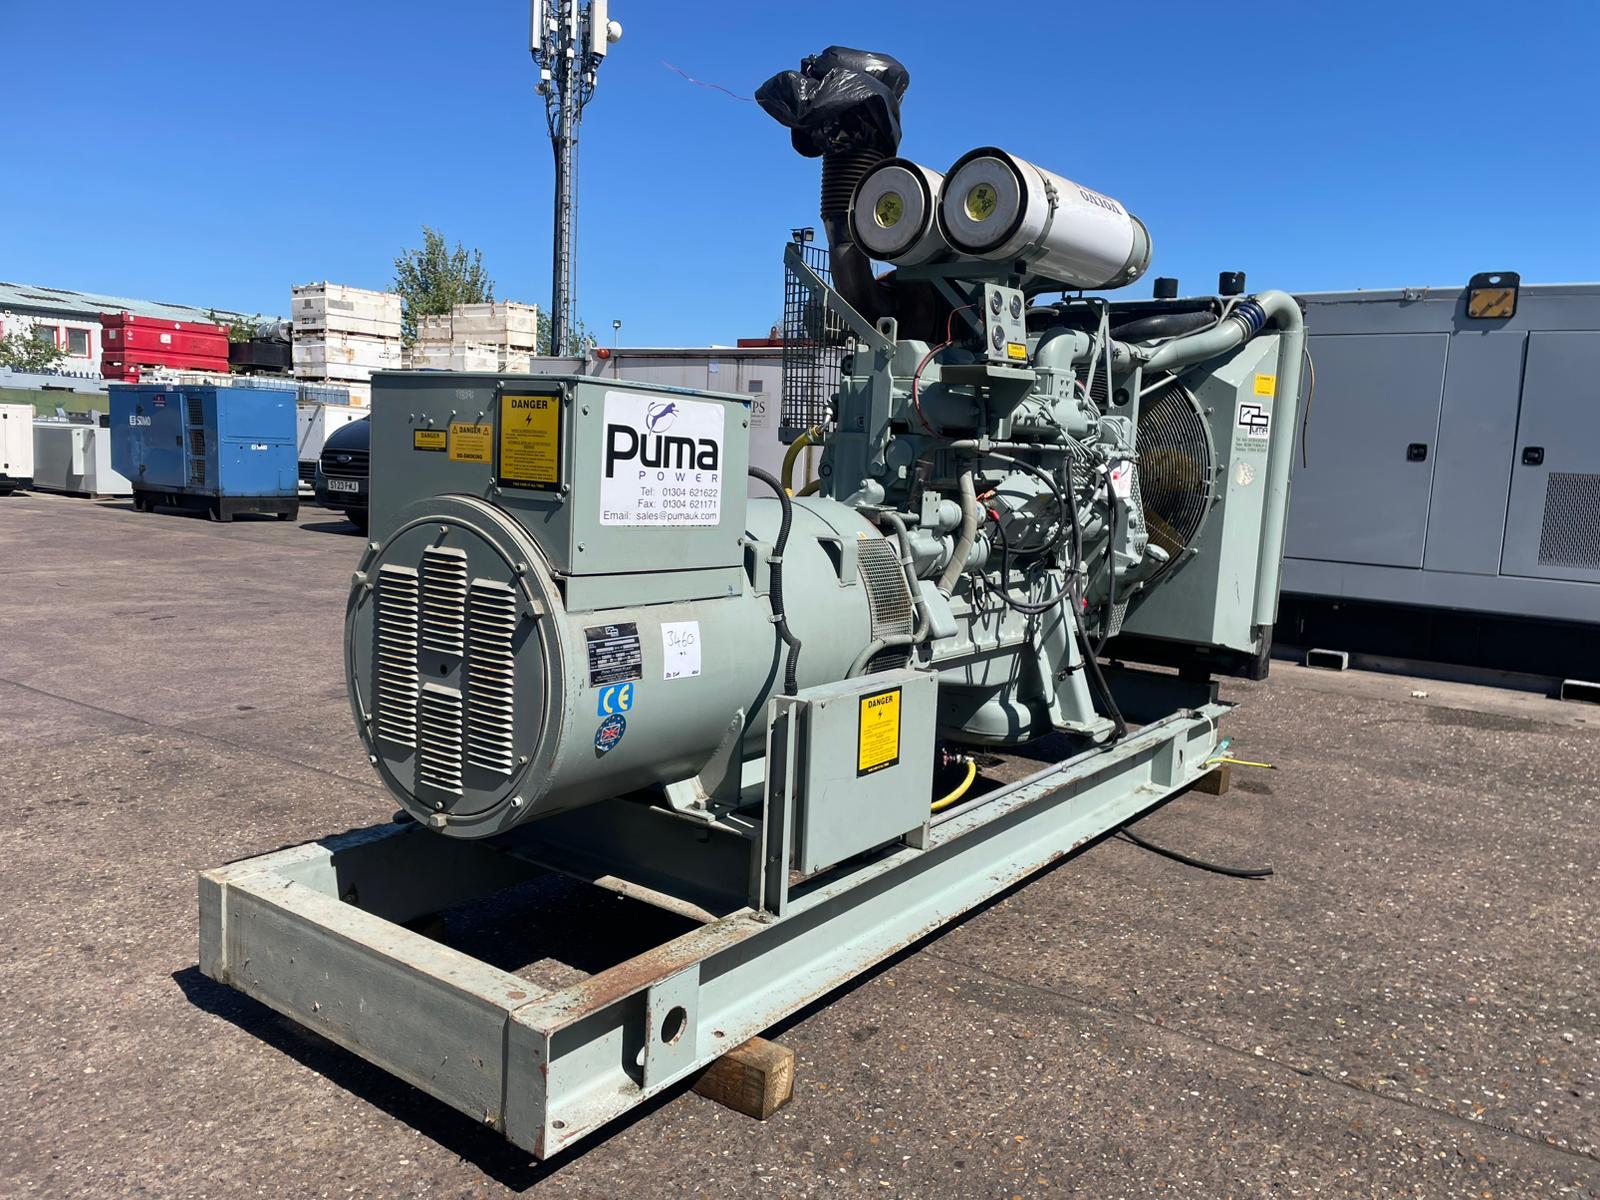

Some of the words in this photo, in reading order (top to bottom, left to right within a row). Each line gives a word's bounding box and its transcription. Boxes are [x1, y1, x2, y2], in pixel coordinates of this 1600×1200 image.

[511, 400, 548, 410] DANGER
[458, 426, 481, 434] DANGER
[639, 470, 718, 483] POWER
[640, 486, 655, 497] Tel:
[662, 487, 686, 498] 01304
[689, 487, 718, 498] 621622
[637, 498, 656, 509] Fax:
[662, 499, 686, 509] 01304
[689, 499, 717, 510] 621171
[603, 510, 632, 521] Email:
[636, 511, 717, 522] sales@pumauk.com
[868, 695, 894, 709] DANGER
